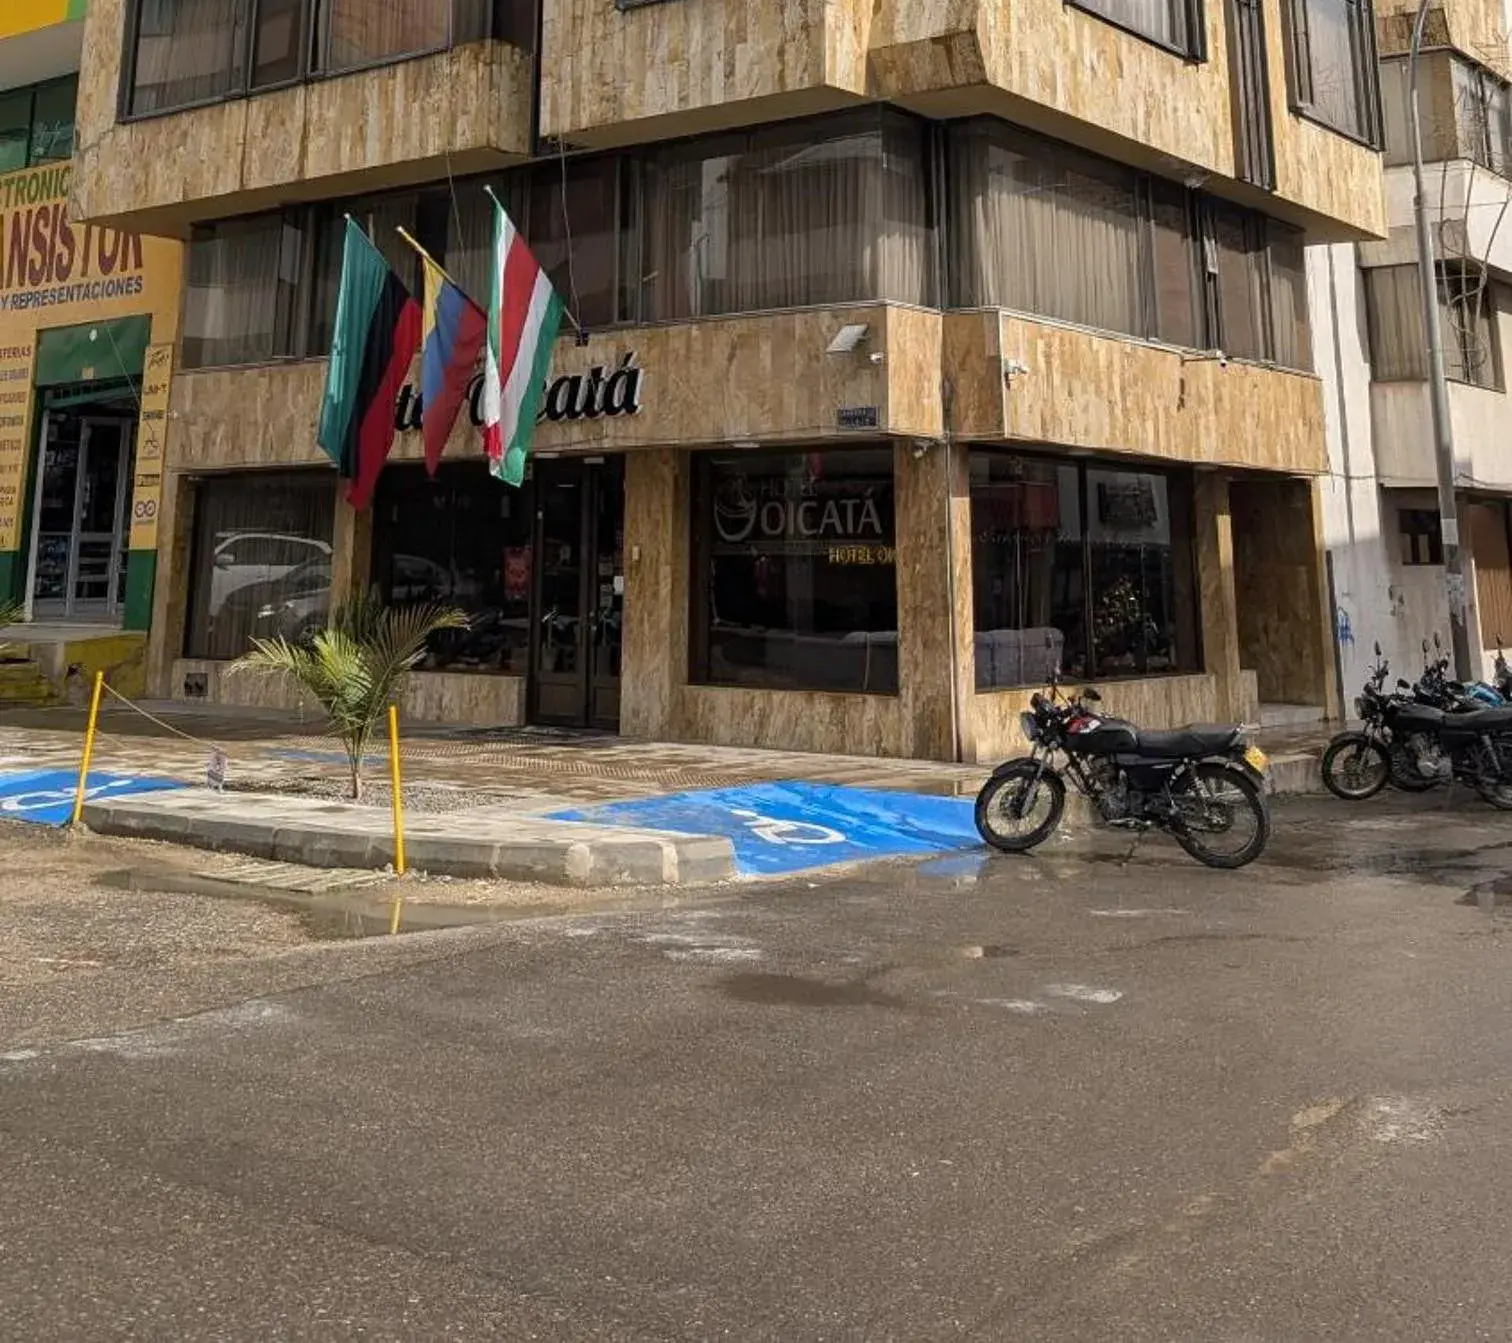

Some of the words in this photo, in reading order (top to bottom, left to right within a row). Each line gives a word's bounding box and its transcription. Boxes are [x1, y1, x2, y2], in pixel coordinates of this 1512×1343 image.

[0, 165, 71, 208] TRONIC
[11, 275, 143, 311] REPRESENTACIONES
[760, 487, 882, 536] OICATÁ
